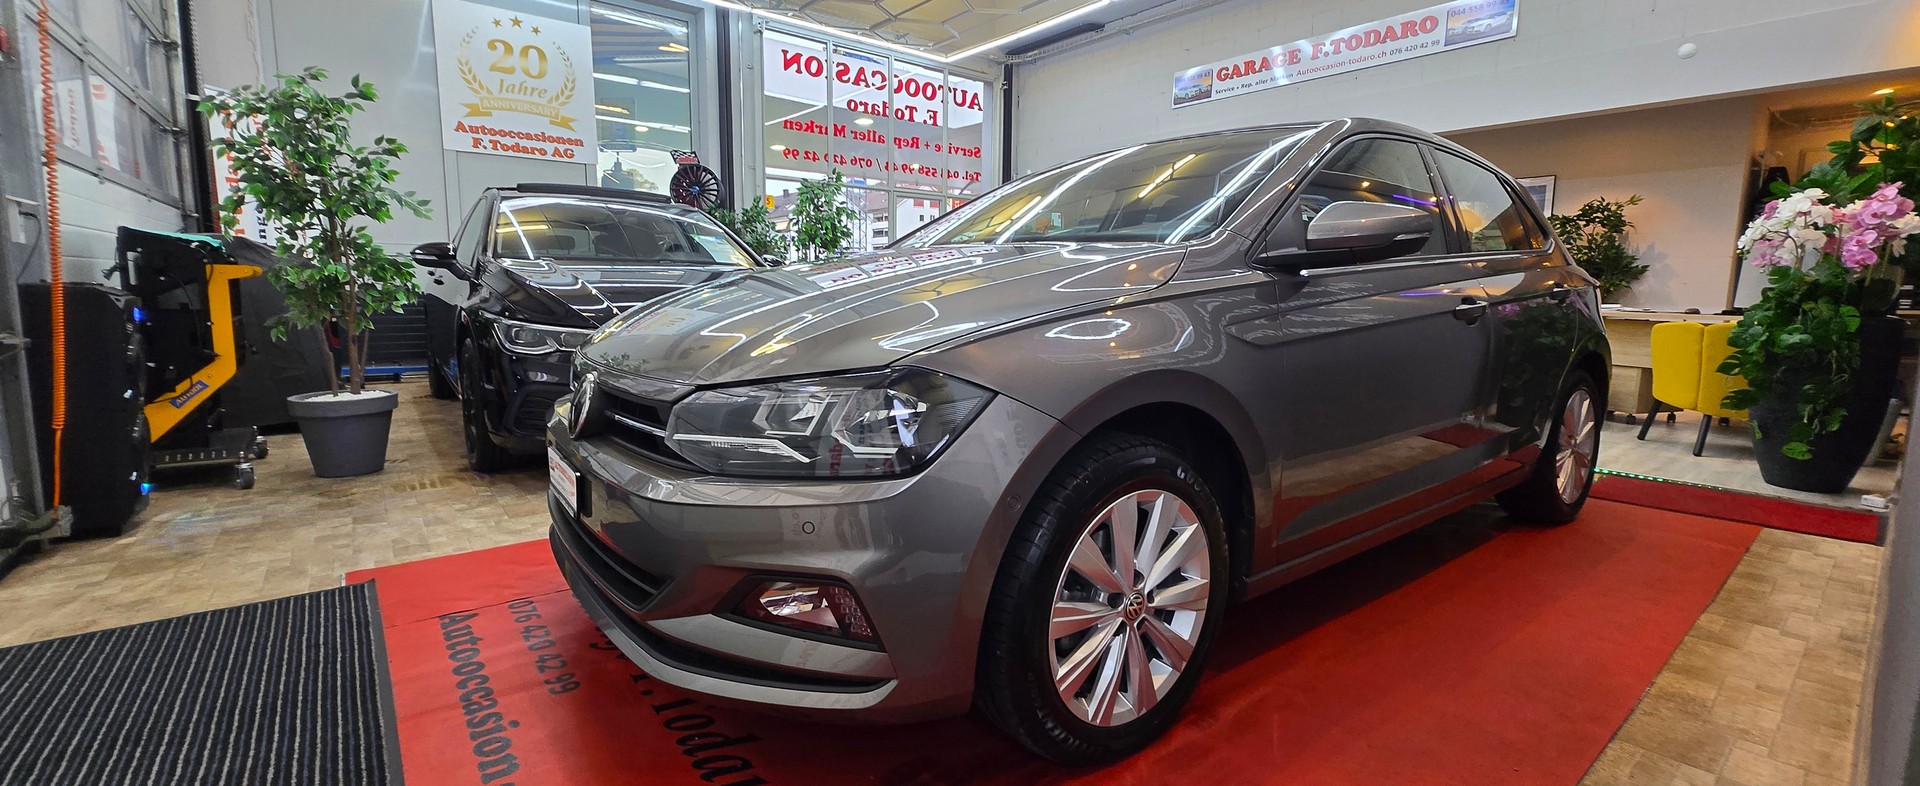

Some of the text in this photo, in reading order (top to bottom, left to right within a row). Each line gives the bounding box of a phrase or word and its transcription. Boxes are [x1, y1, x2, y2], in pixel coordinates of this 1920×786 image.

[486, 38, 549, 80] 20
[1215, 86, 1236, 95] Service
[1255, 78, 1269, 87] aller
[1296, 50, 1388, 77] Autooccasion-todaro.ch
[1389, 46, 1403, 56] 076
[1404, 43, 1418, 53] 420
[1420, 41, 1429, 50] 42
[1431, 38, 1440, 47] 99
[1216, 48, 1302, 82] GARAGE
[497, 79, 548, 99] Jahre
[482, 100, 558, 118] ANNIVERSARY
[454, 120, 584, 147] Autooccasionen
[472, 137, 576, 159] F. Todaro AG
[507, 599, 581, 695] 076 420 42 99
